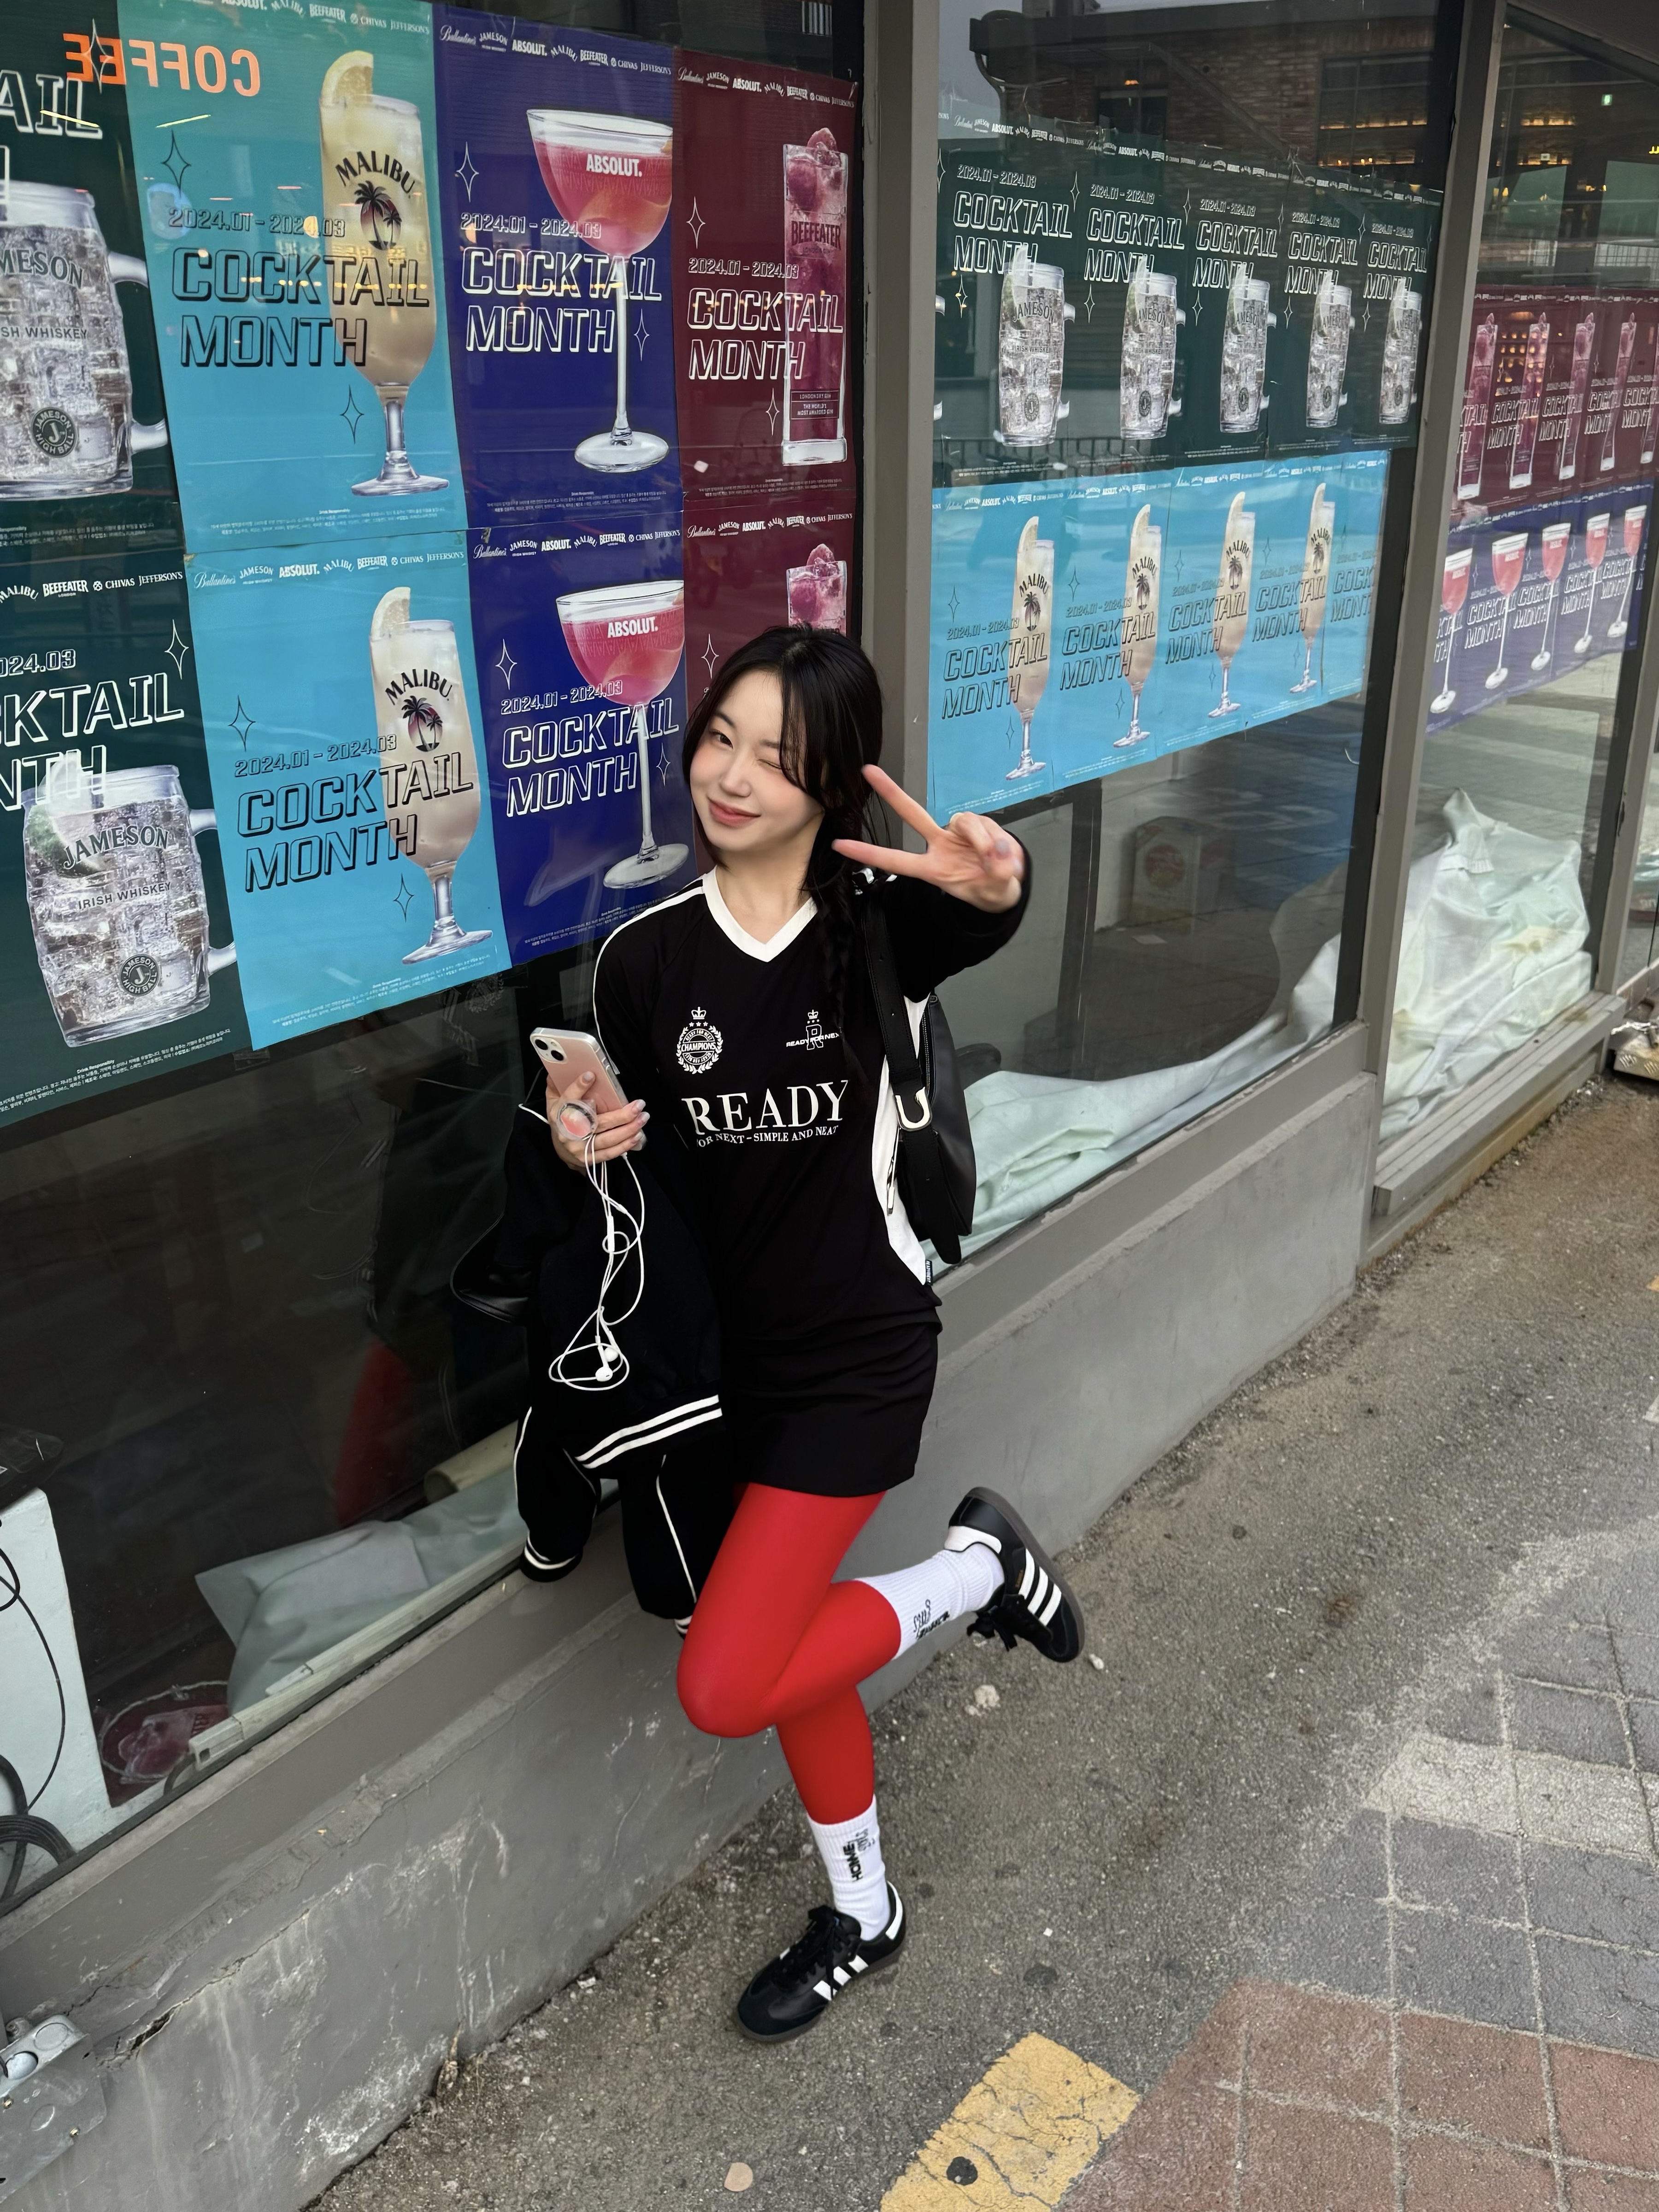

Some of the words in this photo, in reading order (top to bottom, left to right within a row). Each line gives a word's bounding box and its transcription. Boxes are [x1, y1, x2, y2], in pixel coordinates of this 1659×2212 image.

[309, 4, 346, 23] BEEFEATER
[360, 16, 387, 28] CHIVAS
[479, 32, 507, 45] JAMESON
[550, 45, 577, 62] MALIBU
[580, 49, 608, 65] BEEFEATER
[617, 60, 638, 70] CHIVAS
[706, 72, 729, 83] JAMESON
[957, 164, 991, 182] 2024.01
[1000, 171, 1036, 189] 2024.03
[168, 209, 250, 231] 2024.01
[461, 212, 526, 234] 2024.01
[541, 218, 601, 239] 2024.03
[953, 190, 1072, 239] COCKTAIL
[1087, 207, 1185, 251] COCKTAIL
[791, 221, 841, 250] BEEFEATER
[1195, 220, 1278, 258] COCKTAIL
[1288, 231, 1358, 266] COCKTAIL
[461, 247, 662, 301] COCKTAIL
[688, 258, 741, 276] 2024.01
[752, 262, 799, 279] 2024.03
[1367, 241, 1427, 273] COCKTAIL
[172, 247, 429, 307] COCKTAIL
[687, 288, 843, 333] COCKTAIL
[1014, 301, 1055, 323] JAMESON
[27, 328, 87, 340] WHISKEY
[181, 315, 367, 367] MONTH
[466, 305, 615, 353] MONTH
[688, 339, 806, 380] MONTH
[35, 411, 71, 429] JAMESON
[1491, 398, 1539, 424] COCKTAIL
[35, 434, 55, 454] HIGH
[58, 433, 73, 454] BALL
[1487, 424, 1524, 450] MONTH
[510, 540, 538, 551] JAMESON
[574, 535, 597, 548] MALIBU
[600, 533, 626, 545] BEEFEATER
[718, 519, 740, 532] JAMESON
[240, 565, 274, 579] JAMESON
[323, 559, 354, 574] MALIBU
[357, 556, 387, 567] BEEFEATER
[400, 556, 424, 564] CHIVAS
[1019, 573, 1050, 597] MALIBU
[1131, 556, 1158, 579] MALIBU
[42, 580, 88, 597] BEEFEATER
[105, 578, 135, 589] CHIVAS
[1255, 575, 1326, 612] COCKTAIL
[1168, 591, 1247, 633] COCKTAIL
[1252, 608, 1308, 643] MONTH
[1467, 592, 1517, 625] COCKTAIL
[1062, 611, 1156, 656] COCKTAIL
[1165, 626, 1223, 665] MONTH
[943, 633, 1048, 682] COCKTAIL
[1059, 649, 1133, 691] MONTH
[0, 672, 184, 749] KTAIL
[501, 691, 557, 715] 2024.01
[570, 680, 623, 703] 2024.03
[941, 674, 1021, 720] MONTH
[502, 698, 679, 769] COCKTAIL
[235, 750, 309, 777] 2024.01
[327, 734, 397, 762] 2024.03
[237, 752, 474, 837] COCKTAIL
[507, 752, 638, 817] MONTH
[63, 825, 169, 869] JAMESON
[246, 814, 417, 893] MONTH
[78, 893, 112, 910] IRISH
[117, 881, 171, 901] WHISKEY
[123, 957, 155, 976] JAMESON
[123, 979, 141, 993] HIGH
[142, 972, 157, 992] BALL
[681, 1042, 716, 1052] CHAMPIONS
[806, 1024, 824, 1050] R
[681, 1080, 848, 1135] READY
[696, 1136, 713, 1148] OR
[715, 1133, 744, 1144] NEXT
[754, 1132, 788, 1142] SIMPLE
[792, 1130, 813, 1141] AND
[815, 1126, 838, 1136] NEAT
